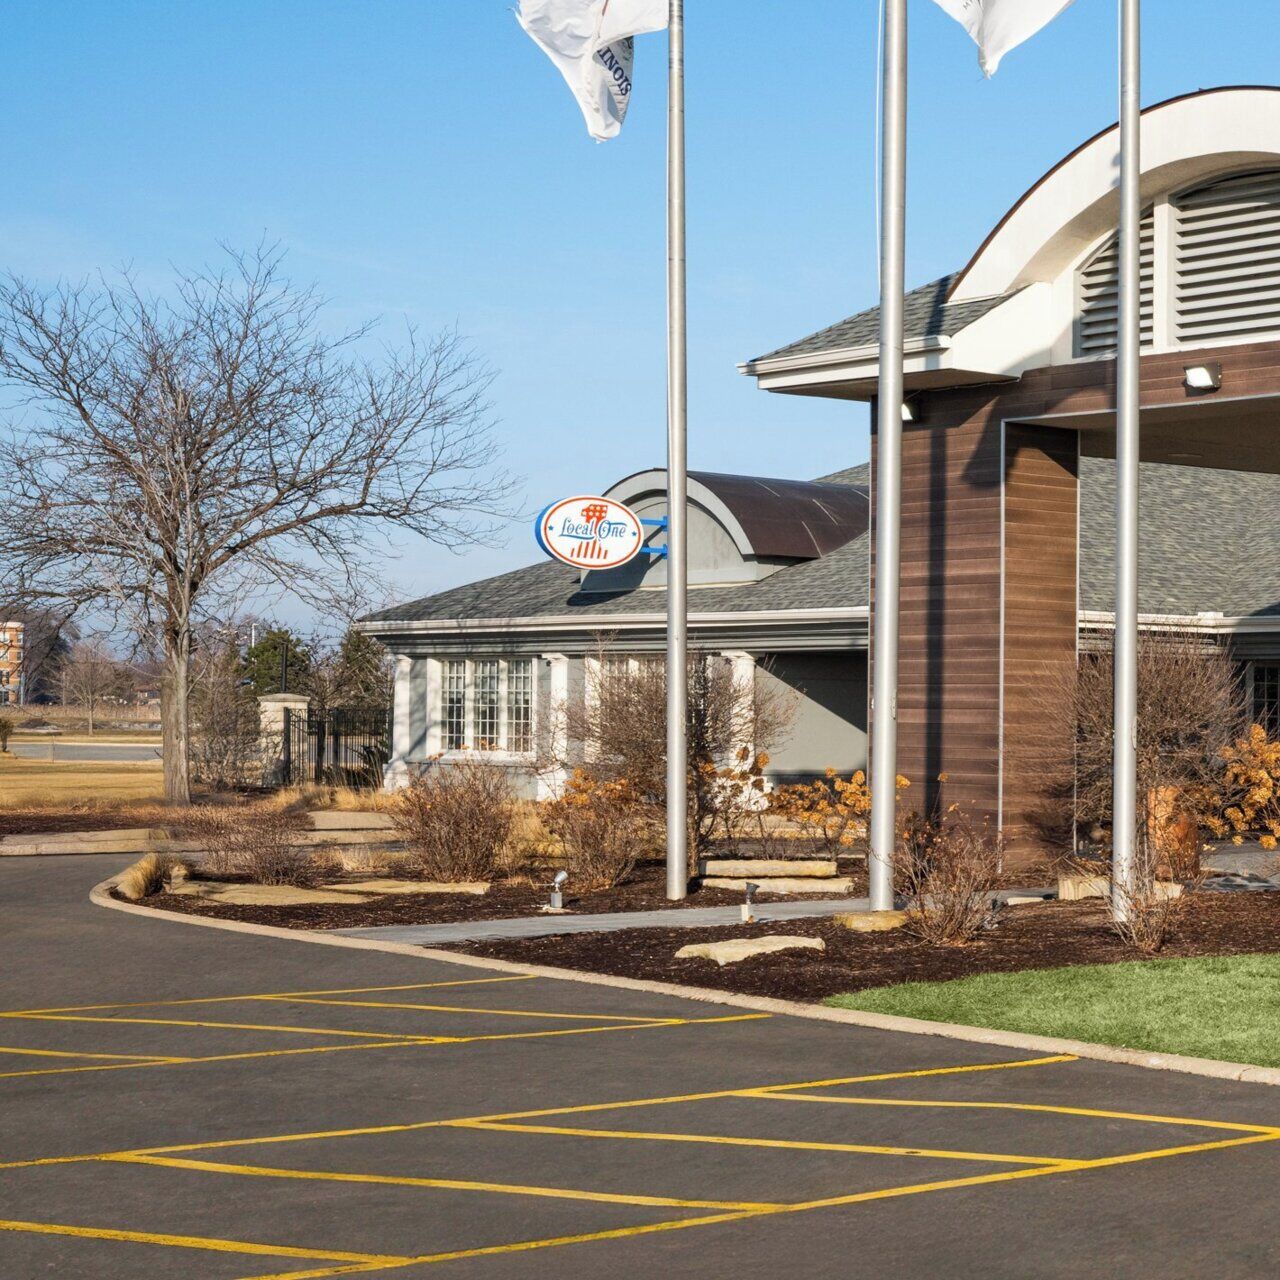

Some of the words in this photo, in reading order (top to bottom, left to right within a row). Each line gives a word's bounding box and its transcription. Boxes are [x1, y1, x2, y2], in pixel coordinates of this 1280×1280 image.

[596, 46, 632, 96] INOIS
[560, 517, 595, 540] Local
[598, 520, 628, 540] One
